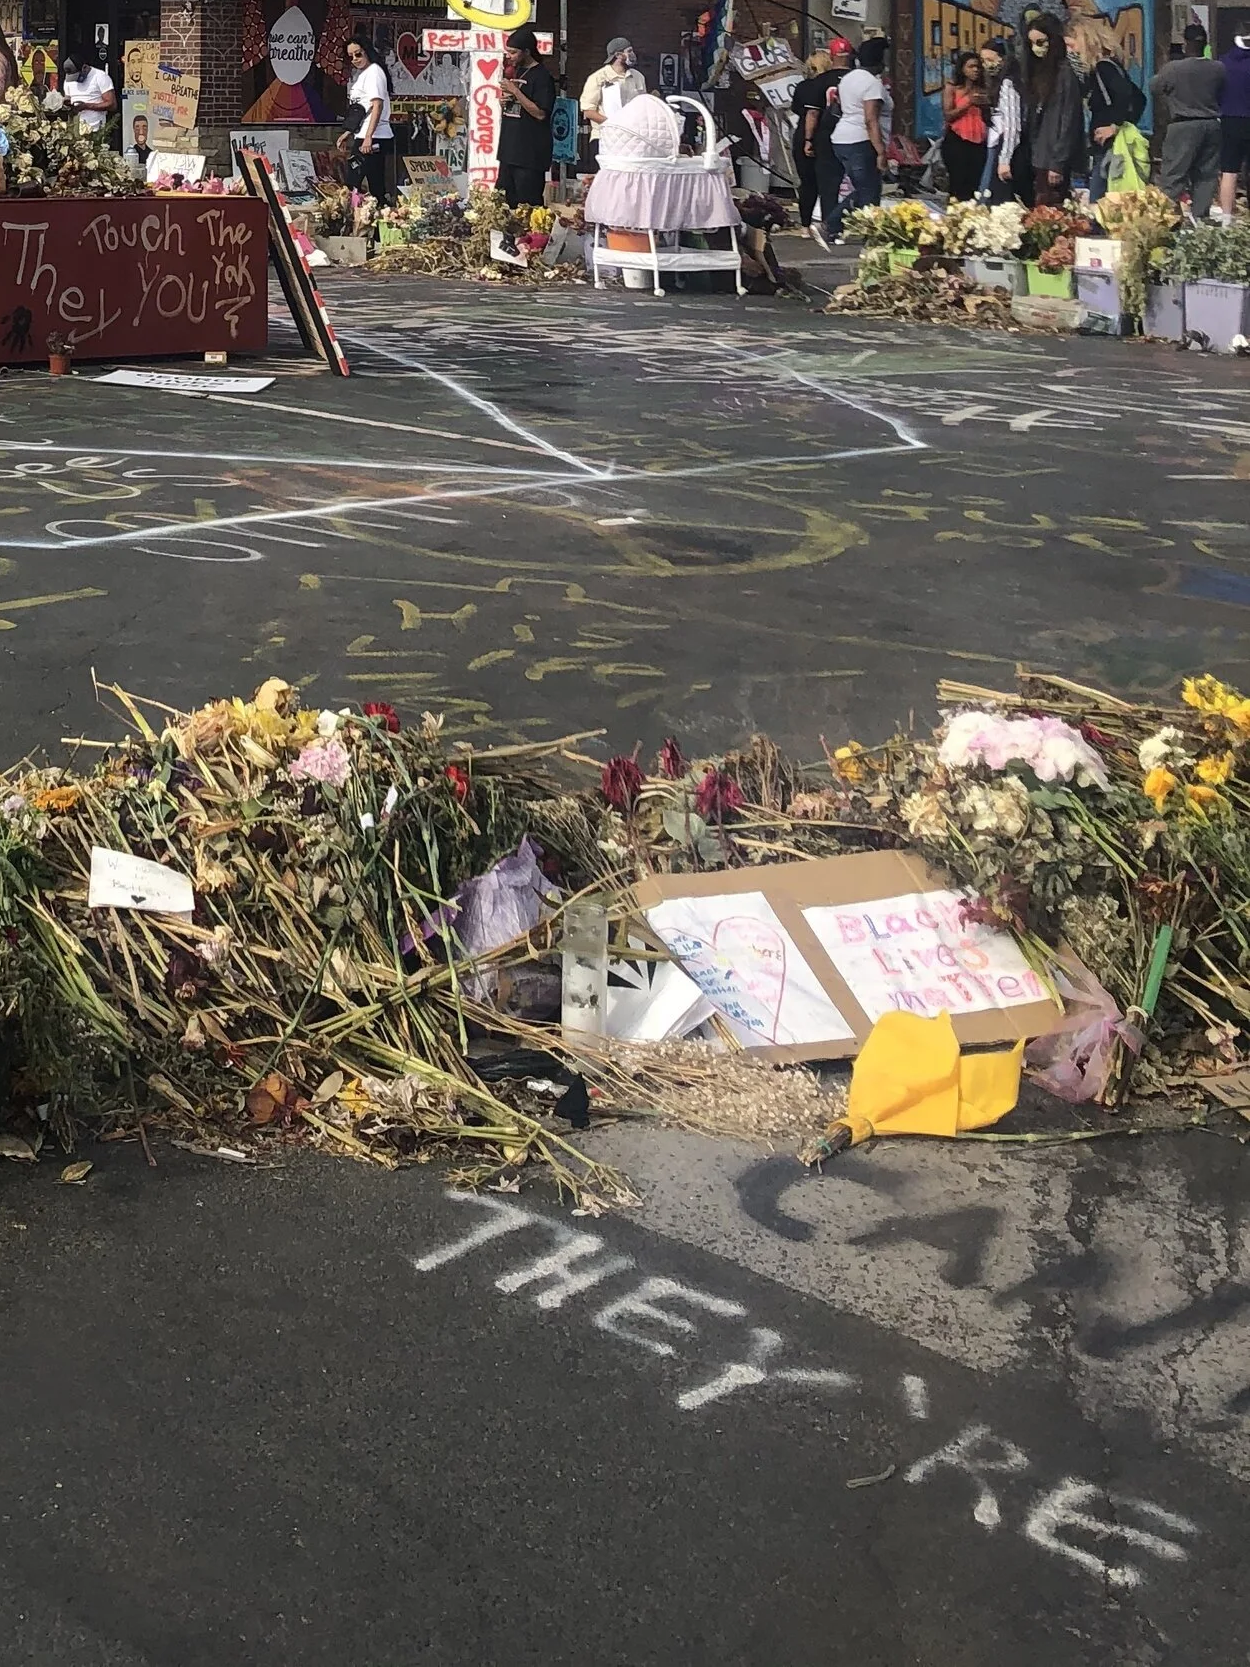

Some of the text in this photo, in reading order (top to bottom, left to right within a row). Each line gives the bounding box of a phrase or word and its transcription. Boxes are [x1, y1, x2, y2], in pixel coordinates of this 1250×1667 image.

[269, 32, 315, 44] we can't
[427, 33, 470, 48] Rest
[476, 33, 496, 48] IN
[269, 43, 314, 62] breathe
